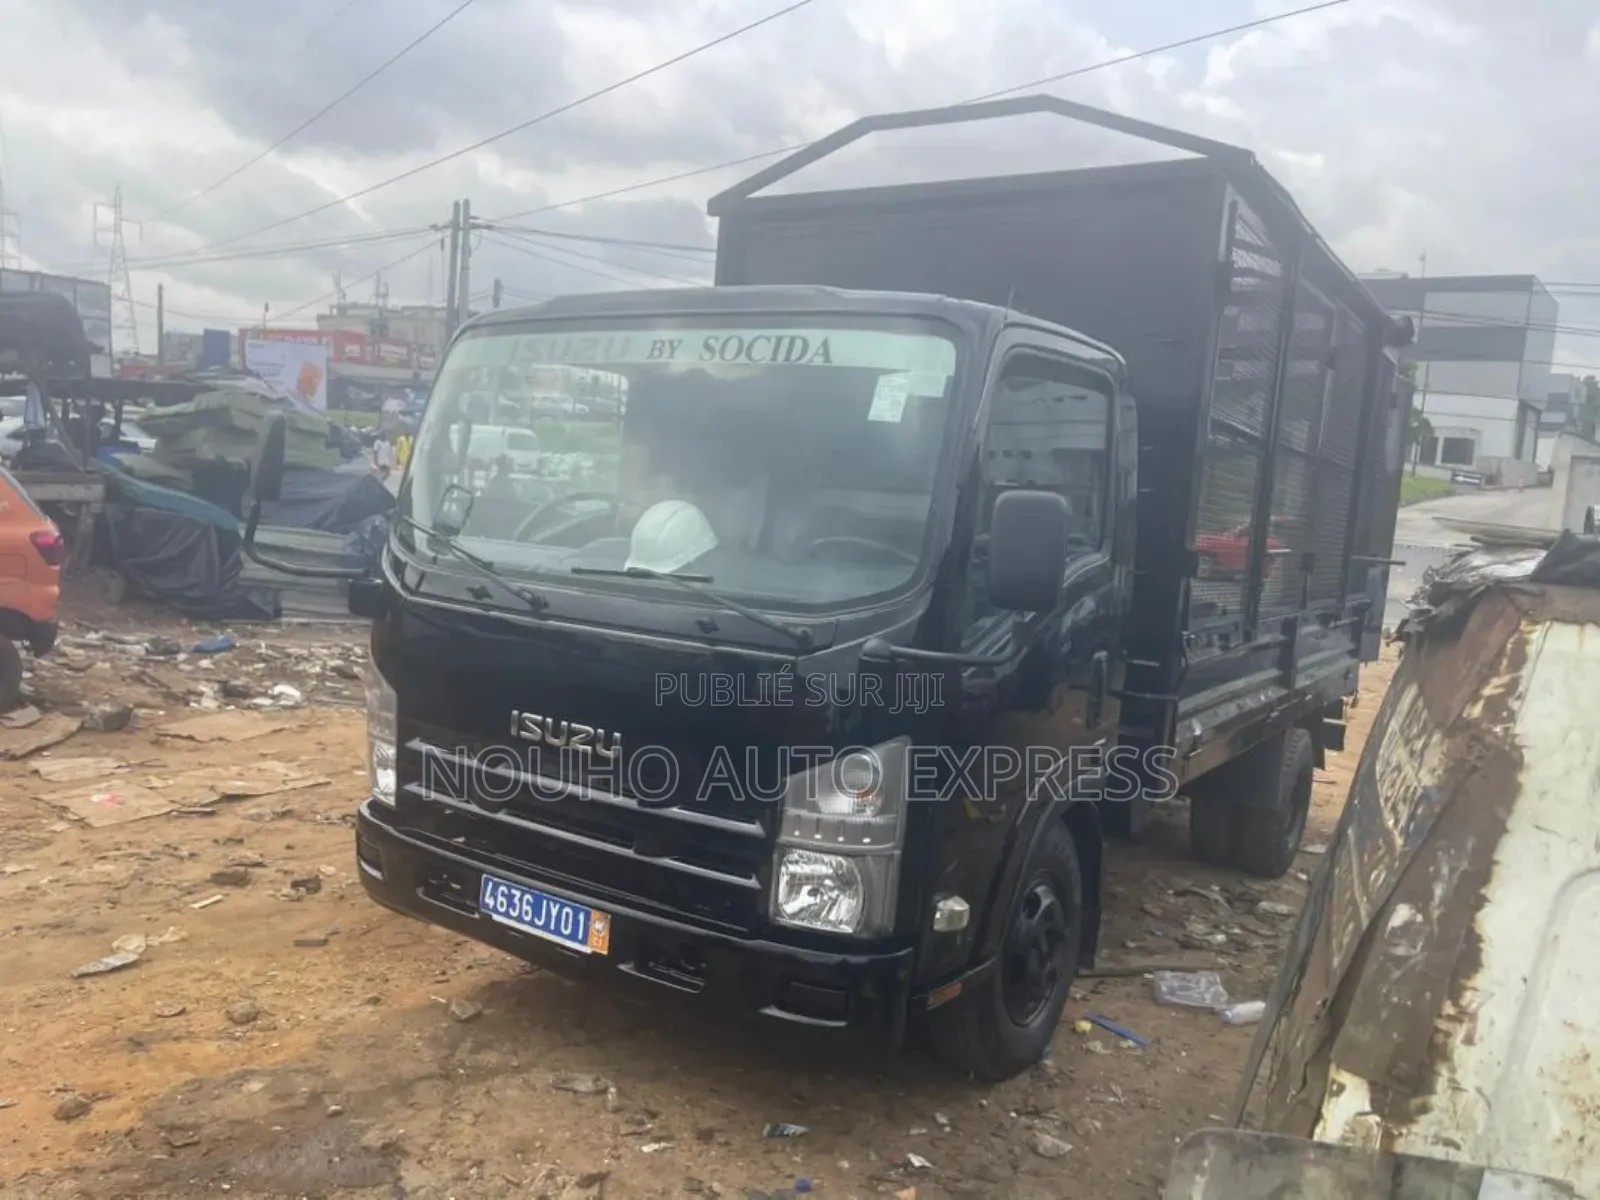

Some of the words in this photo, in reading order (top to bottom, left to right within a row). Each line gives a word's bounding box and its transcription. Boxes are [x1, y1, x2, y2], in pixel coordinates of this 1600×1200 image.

[510, 336, 631, 362] ISUZU
[648, 338, 685, 360] BY
[699, 335, 833, 364] SOCIDA
[509, 709, 622, 759] ISUZU
[484, 880, 586, 941] 4636JY01
